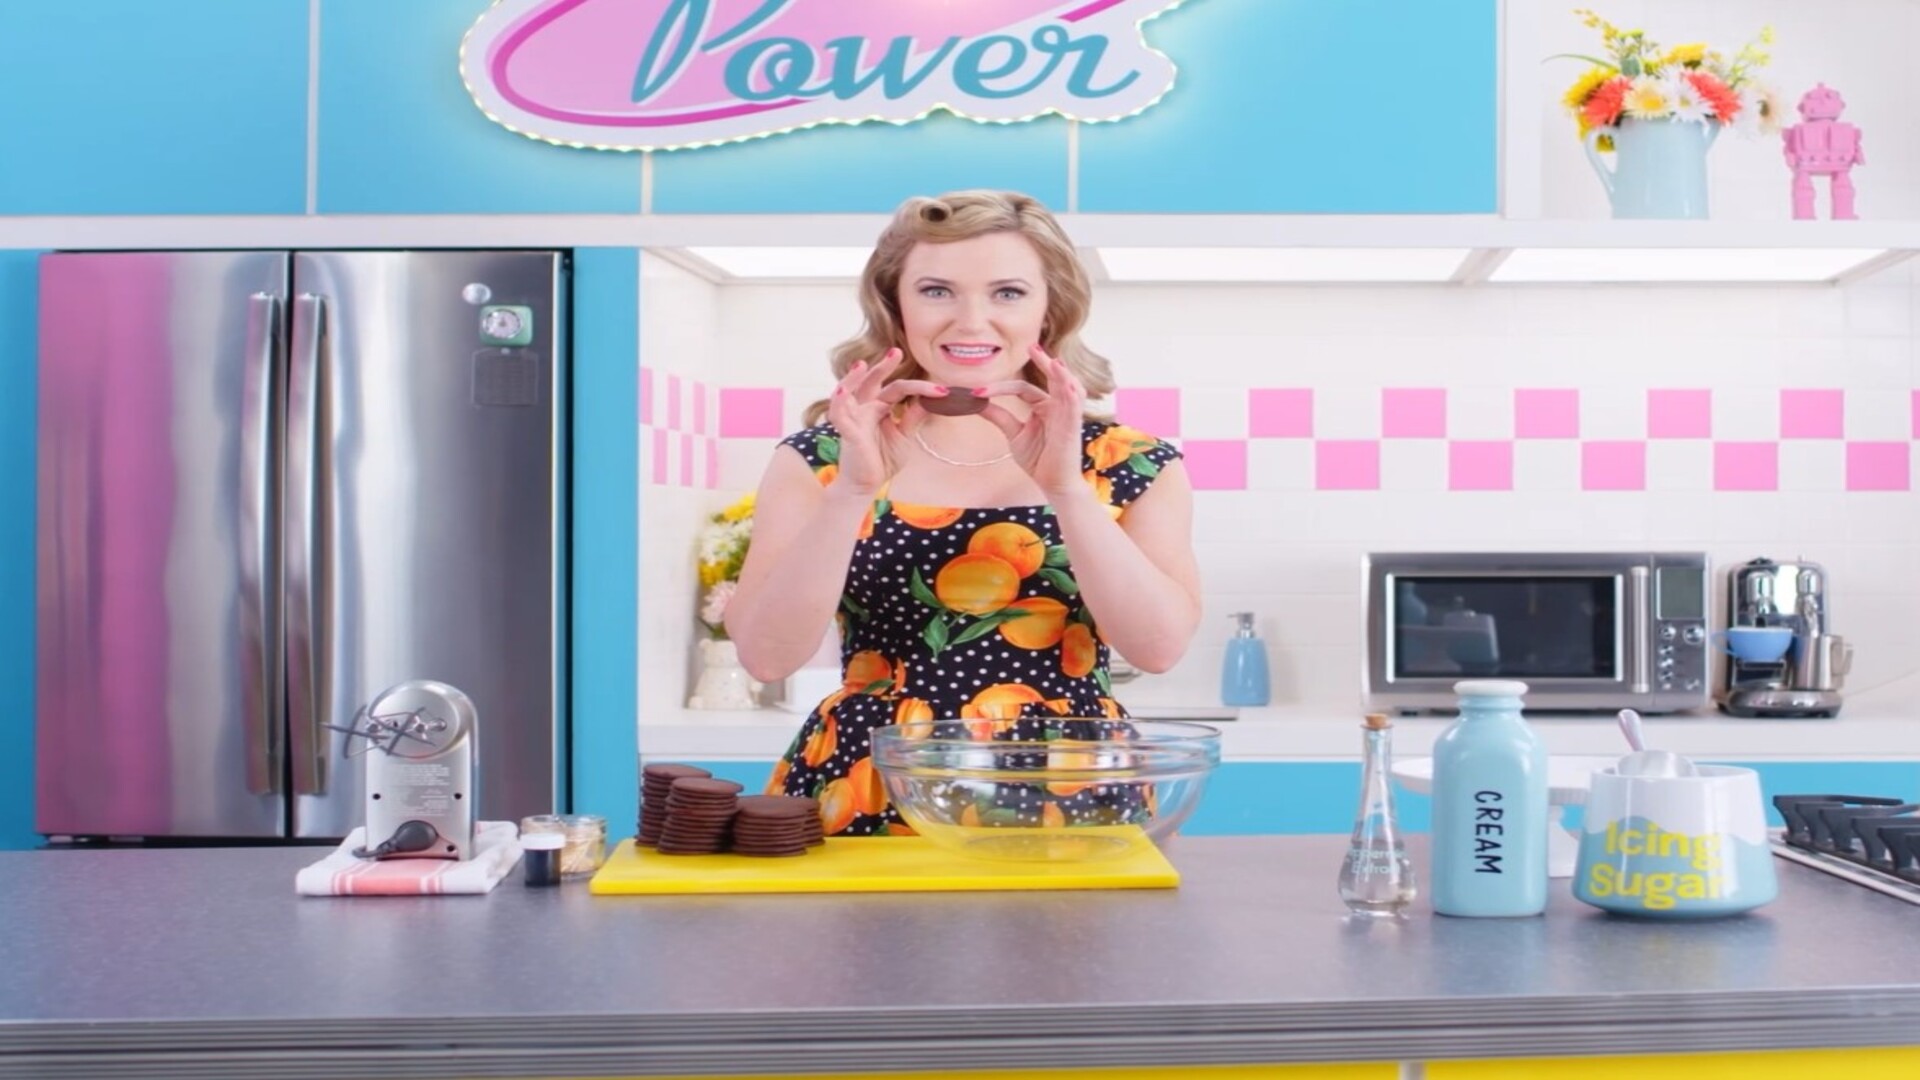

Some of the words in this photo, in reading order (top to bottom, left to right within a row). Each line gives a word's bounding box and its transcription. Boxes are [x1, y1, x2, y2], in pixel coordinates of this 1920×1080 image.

[1474, 790, 1504, 874] CREAM
[1605, 820, 1722, 871] Icing
[1589, 863, 1726, 910] Sugar
